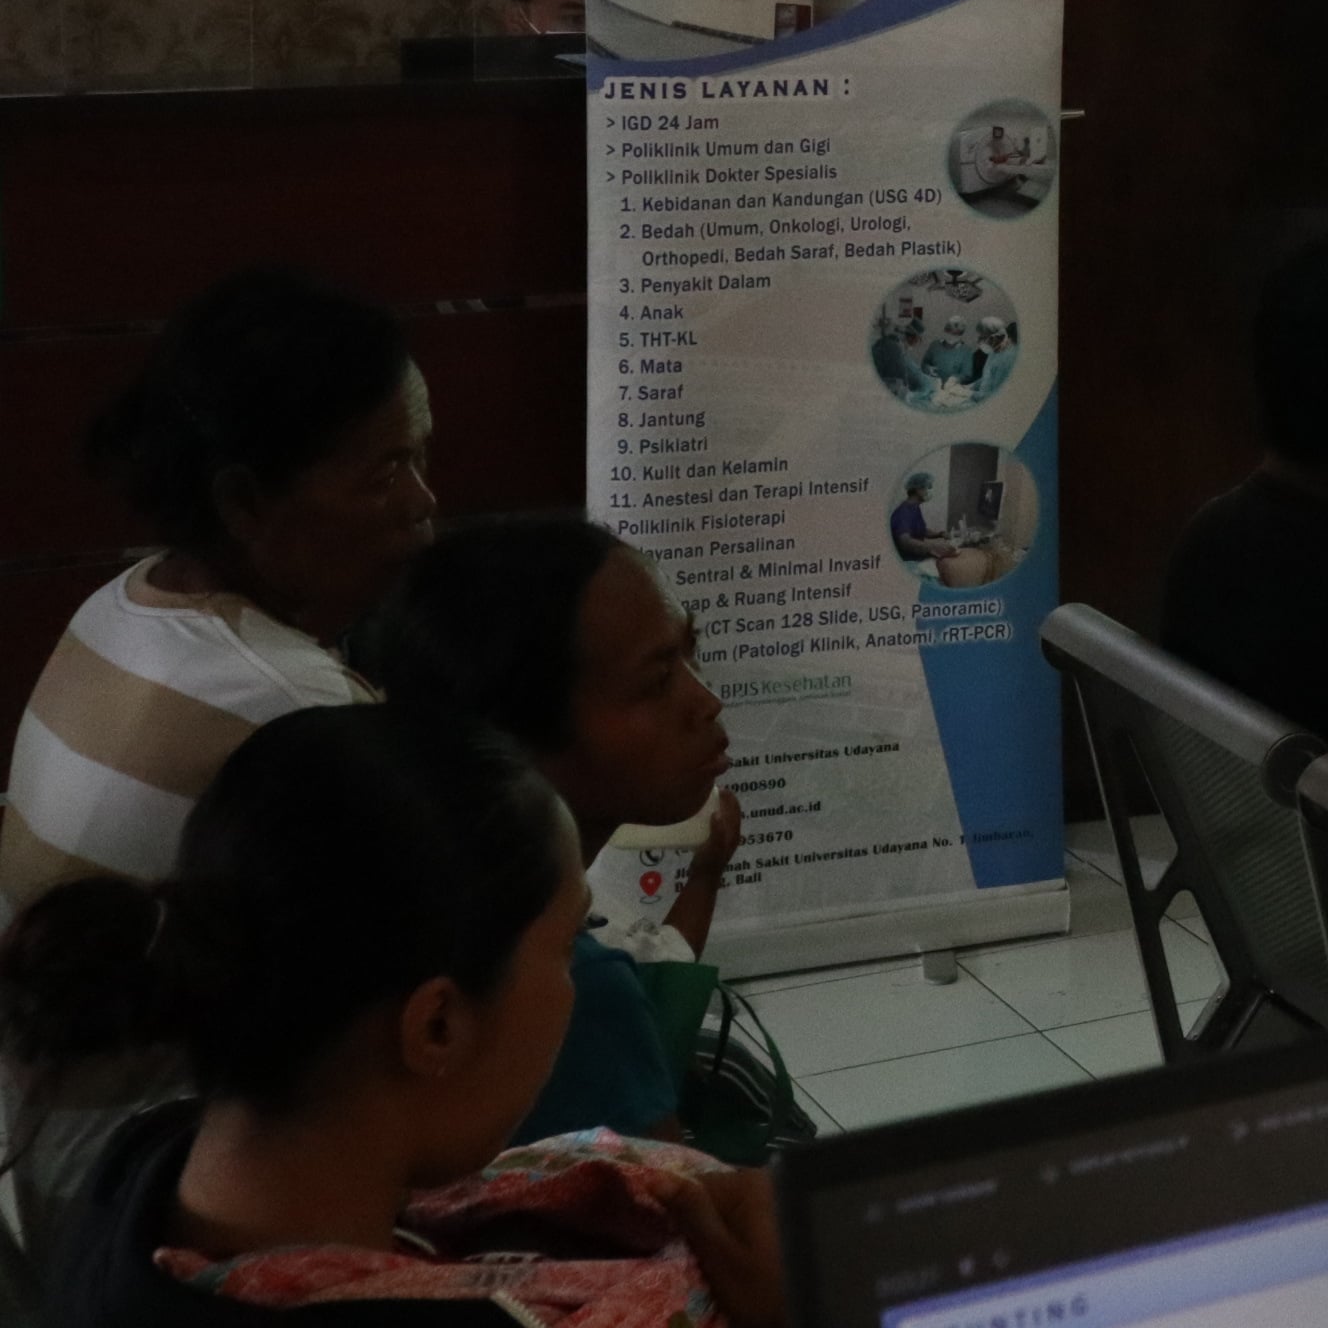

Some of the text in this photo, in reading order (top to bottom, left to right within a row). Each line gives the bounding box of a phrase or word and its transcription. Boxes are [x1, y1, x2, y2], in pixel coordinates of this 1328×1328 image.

[604, 79, 831, 99] JENIS LAYANAN
[622, 114, 719, 130] IGD 24 Jam
[621, 138, 831, 158] Poliklinik Umum dan Gigi
[621, 166, 837, 185] Poliklinik Dokter Spesialis
[621, 189, 942, 212] 1. Kebidanan dan Kandungan (USG 4D)
[620, 215, 911, 240] 2. Bedah (Umum, Onkologi, Urologi,
[642, 240, 962, 270] Orthopedi, Bedah Saraf, Bedah Plastik)
[619, 274, 771, 295] 3. Penyakit Dalam
[619, 305, 684, 321] 4. Anak
[619, 332, 698, 347] 5. THT-KL
[619, 358, 682, 374] 6. Mata
[619, 385, 683, 401] 7. Saraf
[618, 411, 705, 430] 8. Jantung
[618, 437, 708, 454] 9. Psikiatri
[610, 457, 788, 482] 10. Kulit dan Kelamin
[610, 477, 869, 508] 11. Anestesi dan Terapi Intensif
[618, 510, 786, 535] Poliklinik Fisioterapi
[710, 537, 795, 558] Persalinan
[676, 555, 881, 585] Sentral & Minimal Invasif
[717, 583, 852, 609] & Ruang Intensif
[705, 600, 1002, 639] (CT Scan 128 Slide, USG, Panoramic)
[733, 639, 806, 662] (Patologi
[810, 633, 861, 652] Klinik,
[866, 629, 937, 649] Anatomi,
[943, 622, 1011, 642] rRT-PCR)
[721, 675, 851, 699] BPJS Kesehatan
[728, 742, 900, 769] Sakit Universitas Udayana
[756, 853, 790, 870] Sakit
[794, 845, 868, 865] Universitas
[873, 840, 928, 857] Udayana
[932, 837, 953, 849] No.
[736, 871, 762, 885] Bali
